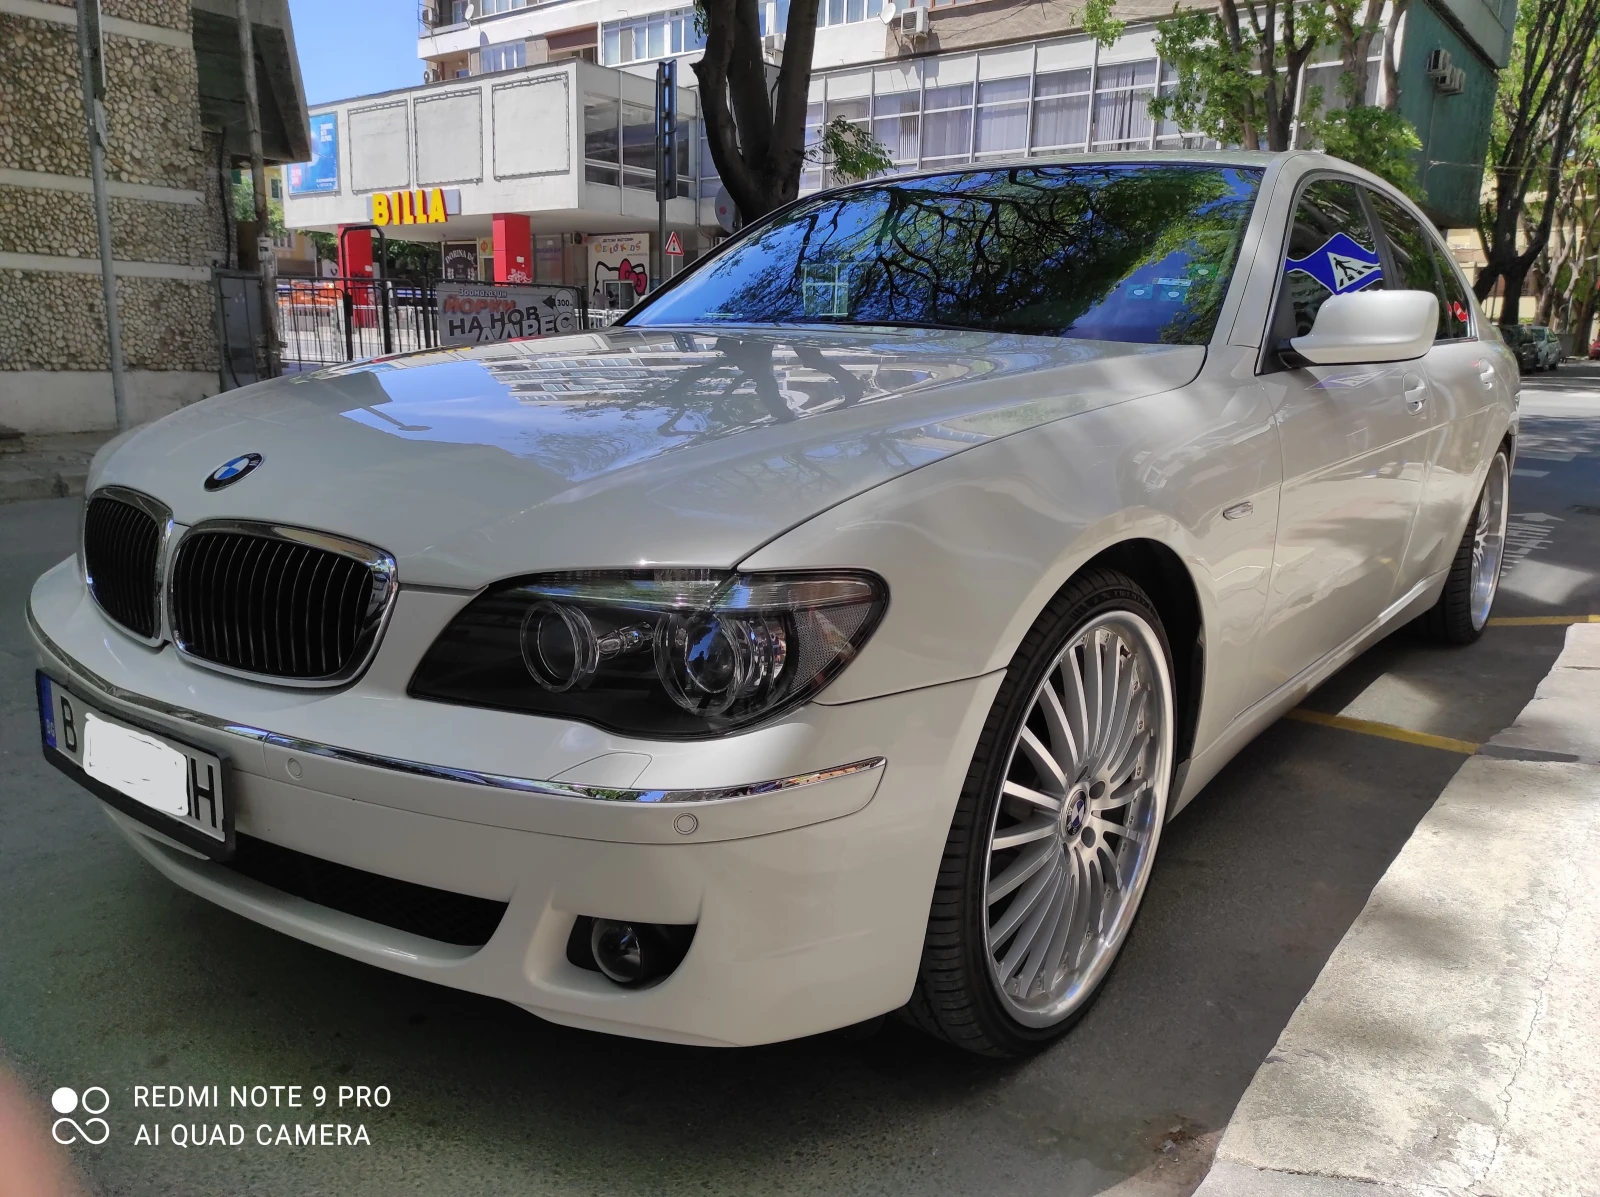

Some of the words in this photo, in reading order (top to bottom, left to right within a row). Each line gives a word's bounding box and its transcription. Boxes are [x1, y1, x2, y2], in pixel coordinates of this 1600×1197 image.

[373, 188, 448, 226] BILLA
[443, 294, 516, 314] ЙОРКИ
[459, 288, 507, 298] Зоомагазин
[557, 299, 570, 307] 300
[448, 316, 484, 337] НА
[490, 306, 539, 329] НОВ
[60, 695, 77, 753] B
[184, 754, 217, 829] H
